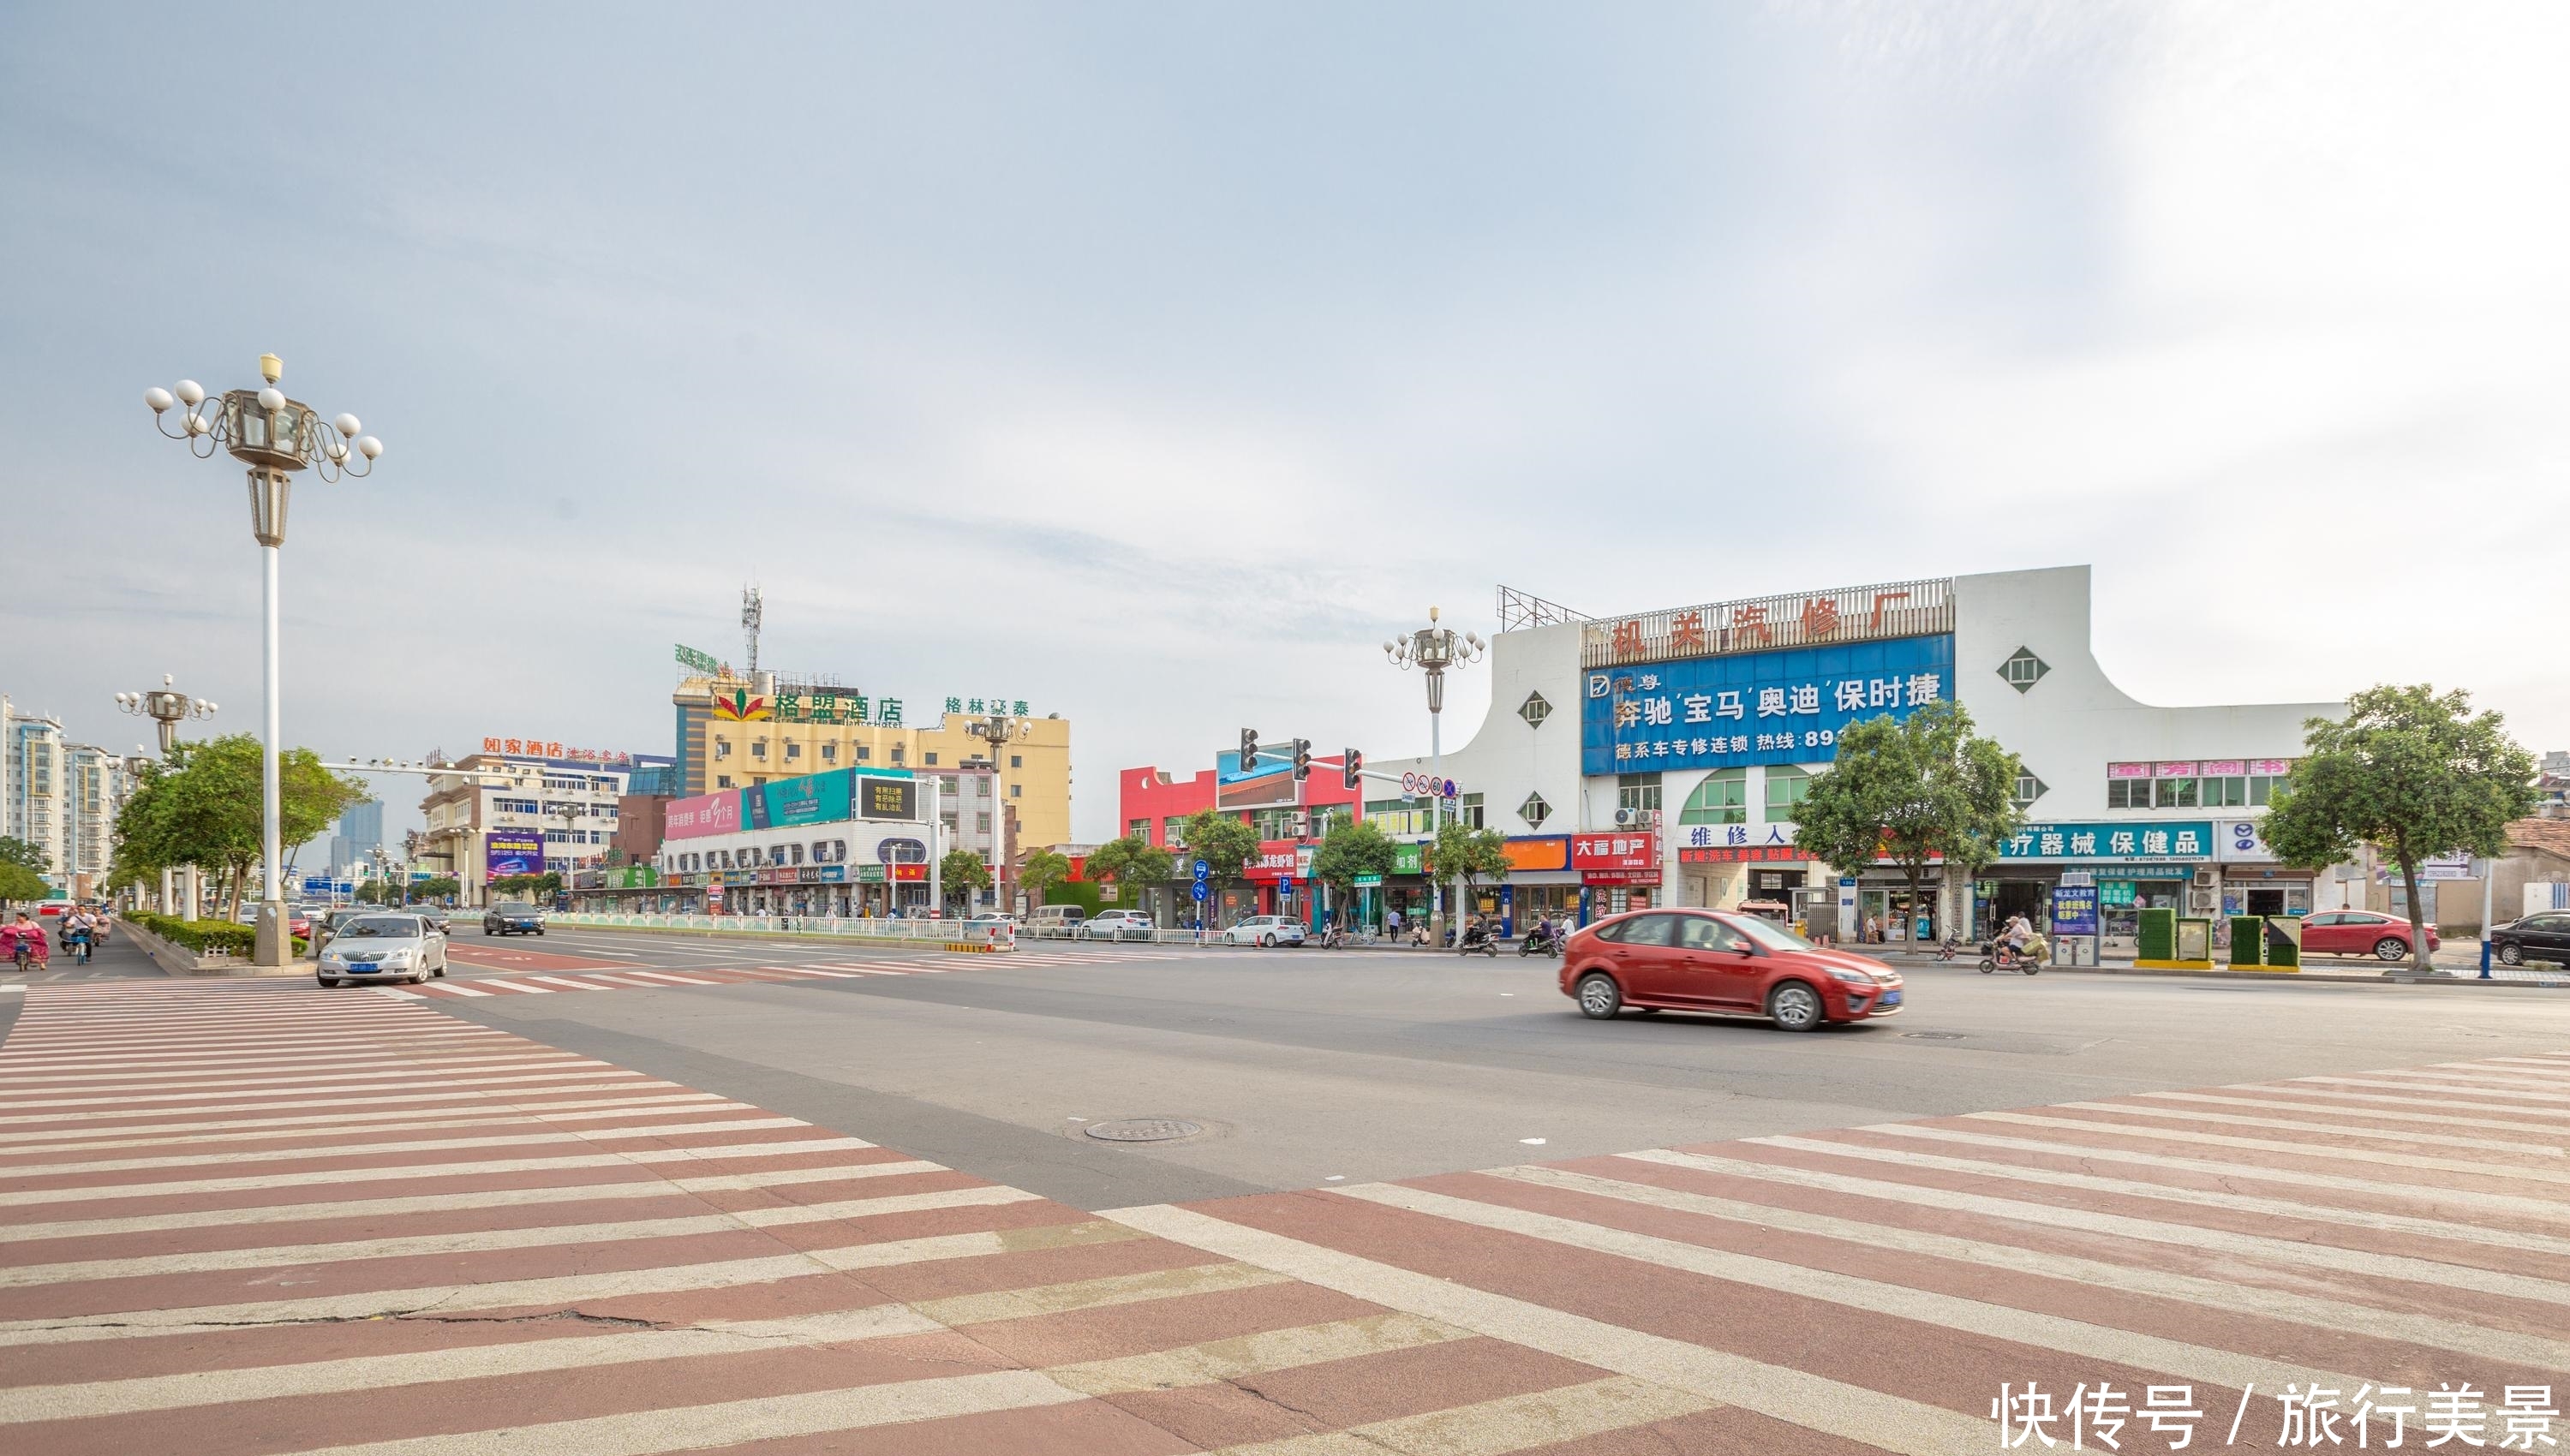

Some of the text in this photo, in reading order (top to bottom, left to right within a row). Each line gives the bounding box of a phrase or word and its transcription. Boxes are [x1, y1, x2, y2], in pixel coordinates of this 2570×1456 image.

[1612, 593, 1910, 656] 机关汽修厂
[483, 737, 563, 758] 如家酒店
[1616, 735, 1748, 760] 德系车专修连锁
[1577, 839, 1645, 856] 大福地产
[2110, 831, 2200, 855] 保健品
[1282, 879, 1289, 892] P
